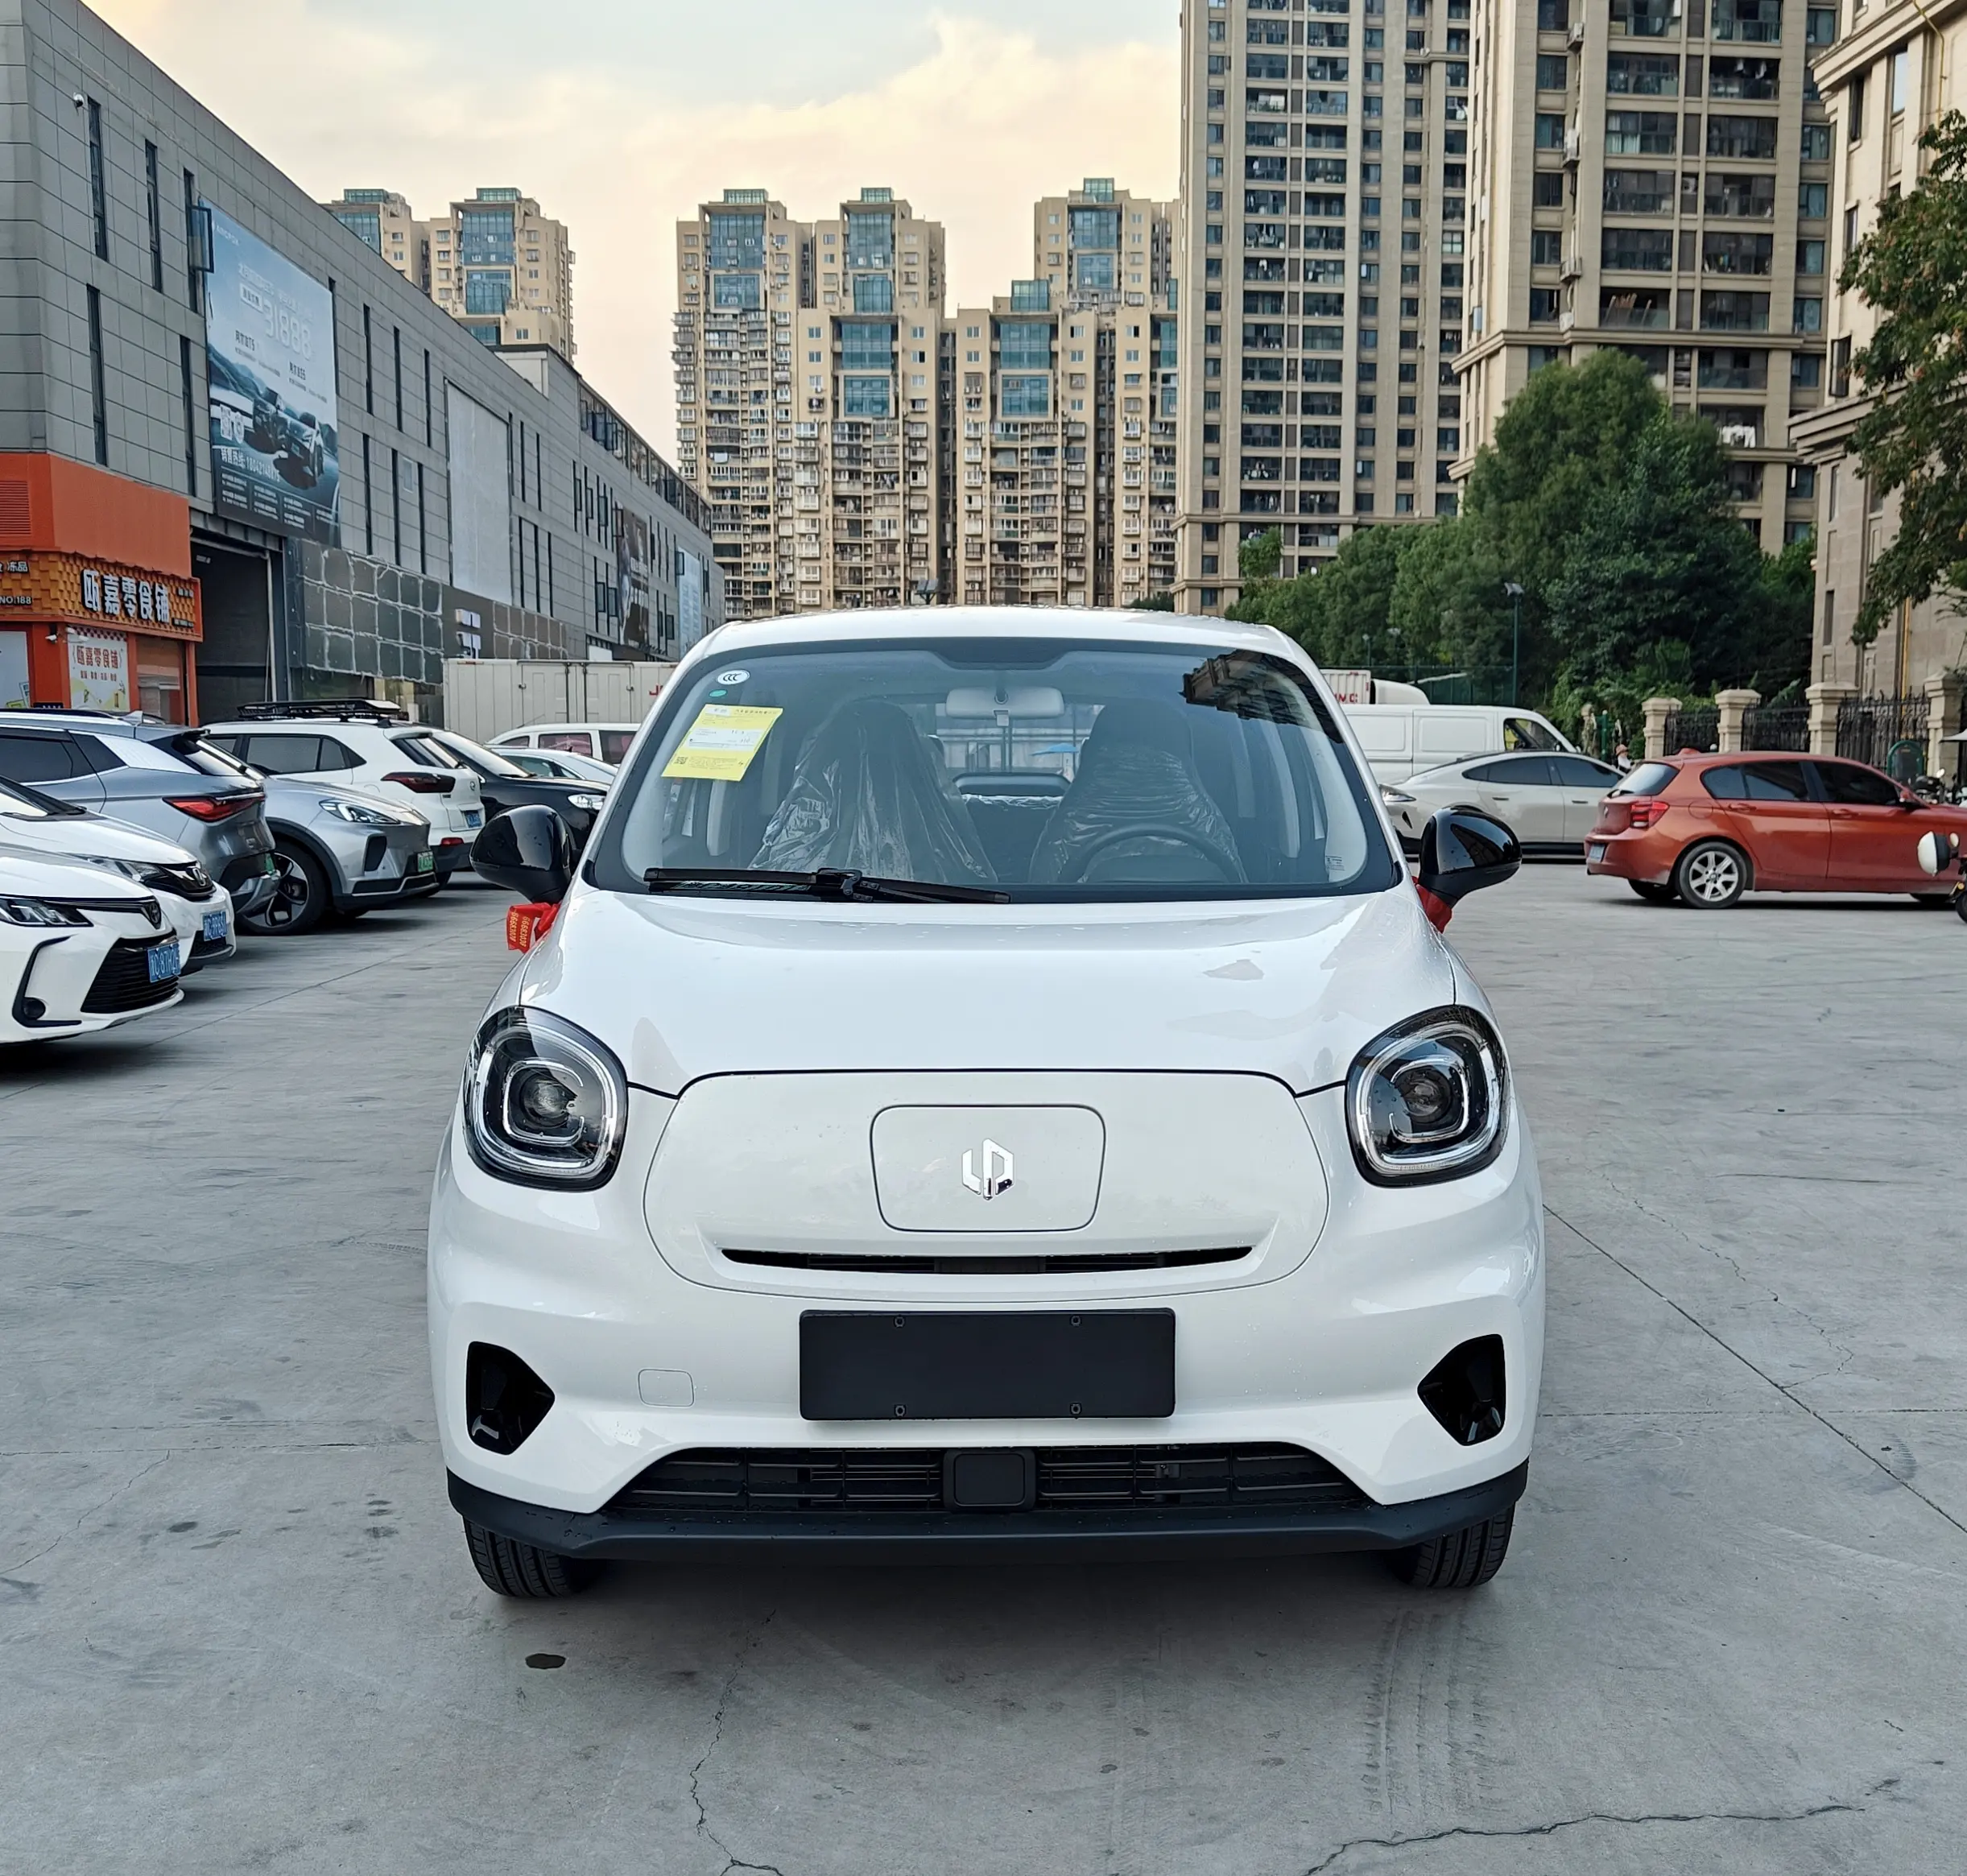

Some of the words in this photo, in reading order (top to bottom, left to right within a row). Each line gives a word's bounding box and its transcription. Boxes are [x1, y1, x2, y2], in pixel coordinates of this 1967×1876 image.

[83, 568, 170, 624] 瓯嘉零食铺
